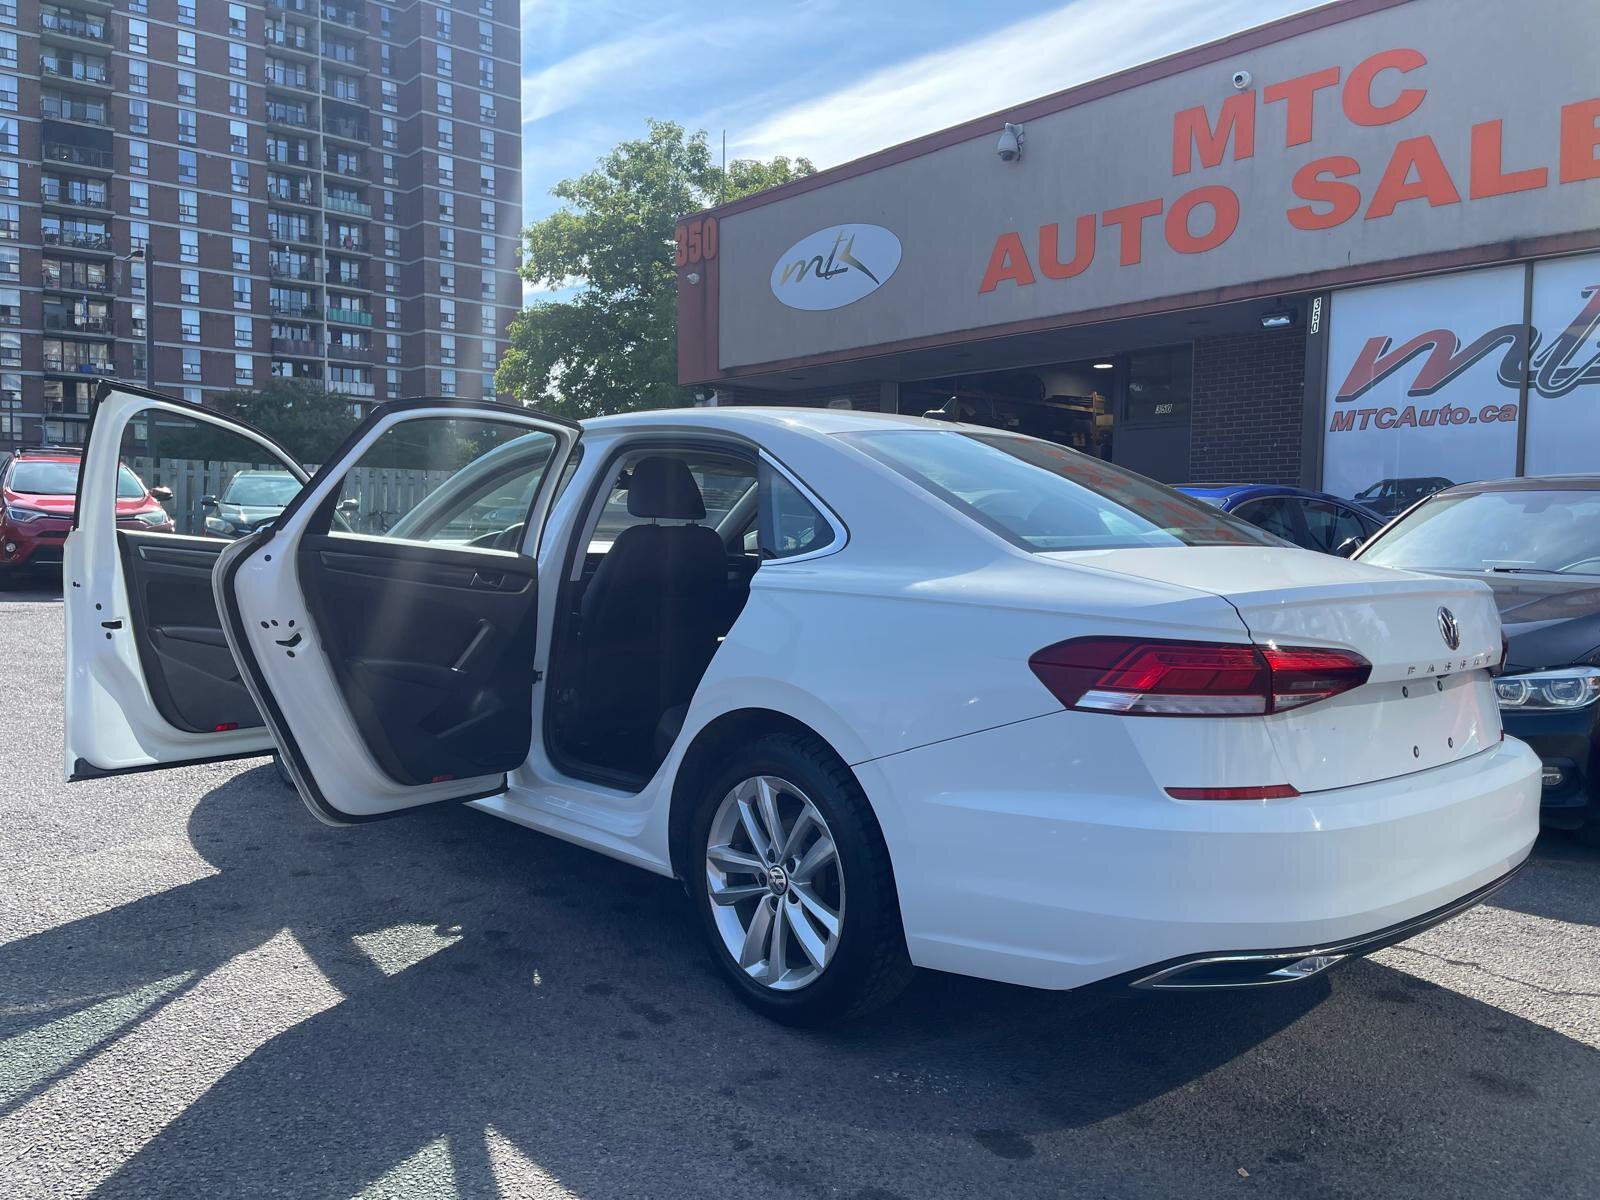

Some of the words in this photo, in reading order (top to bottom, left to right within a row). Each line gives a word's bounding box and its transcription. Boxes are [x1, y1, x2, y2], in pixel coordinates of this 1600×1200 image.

[1172, 48, 1428, 176] MTC
[674, 216, 718, 267] 350
[978, 185, 1240, 294] AUTO
[1312, 298, 1321, 333] 350
[1329, 403, 1519, 432] MTCAuto.ca
